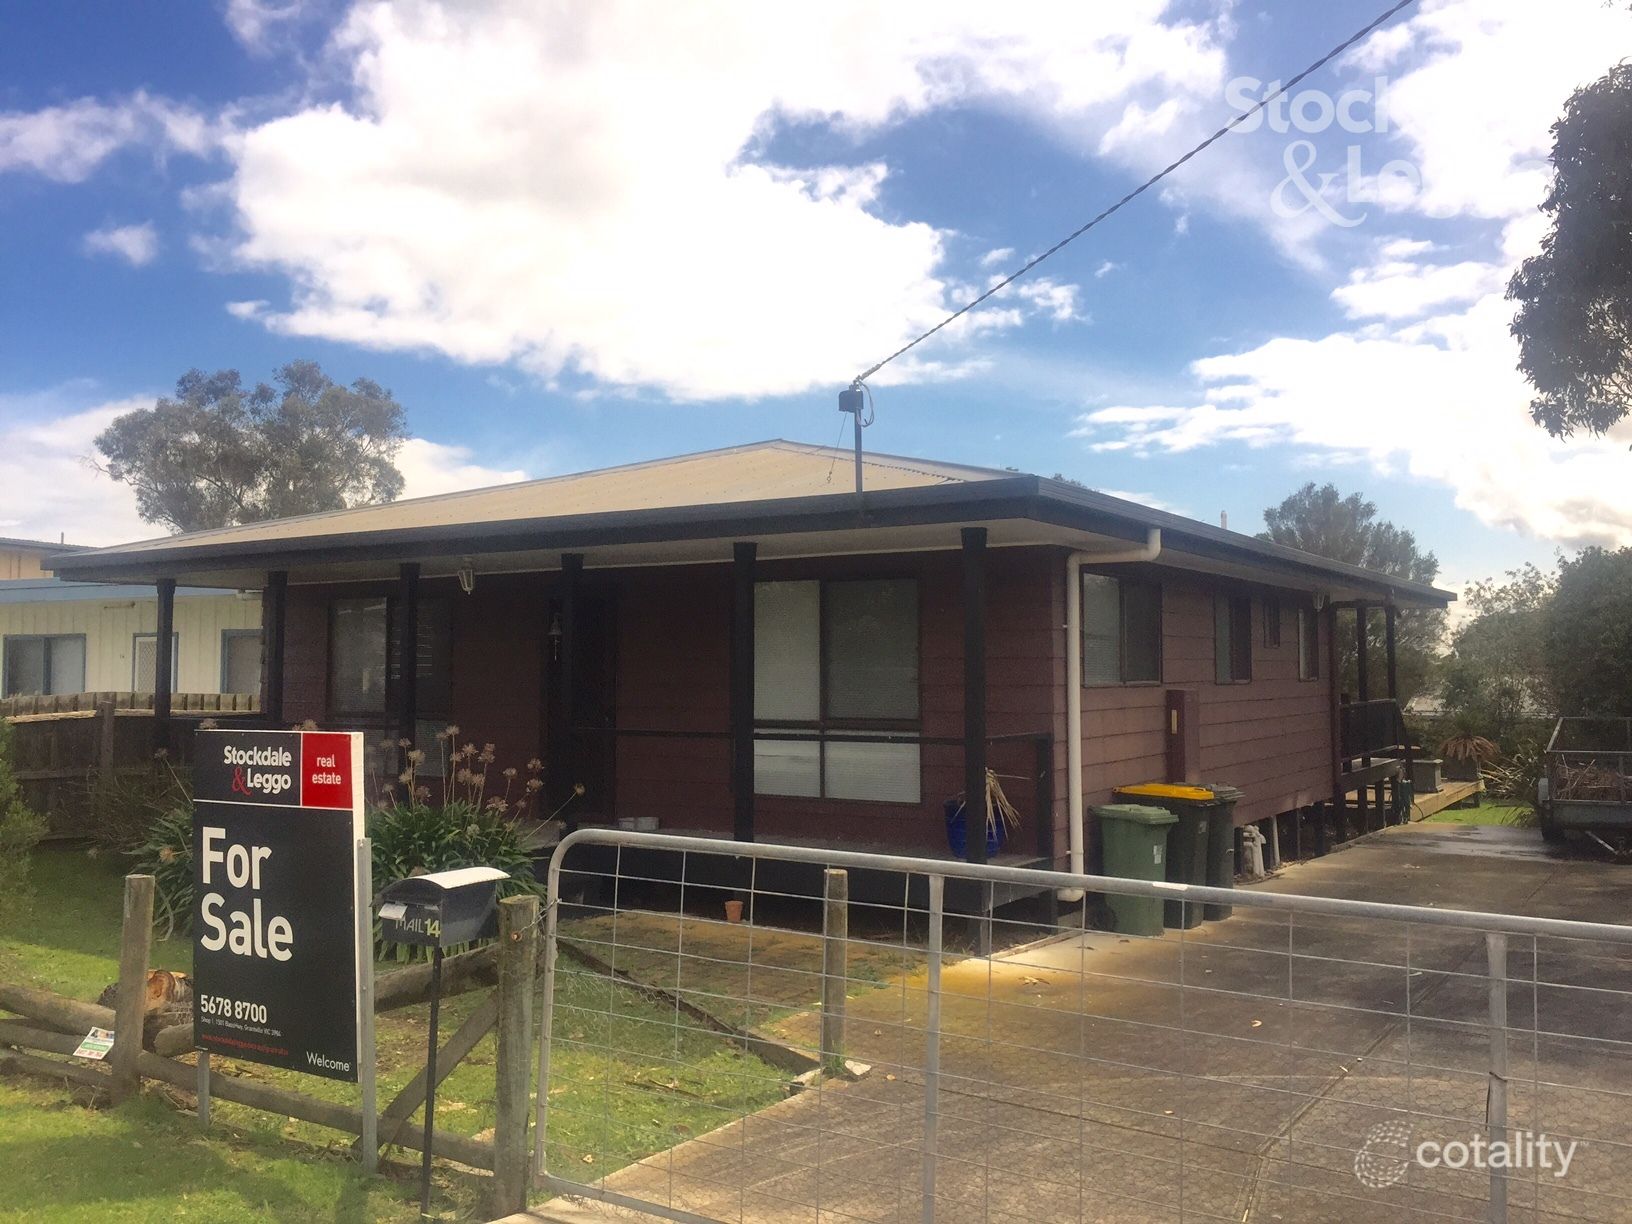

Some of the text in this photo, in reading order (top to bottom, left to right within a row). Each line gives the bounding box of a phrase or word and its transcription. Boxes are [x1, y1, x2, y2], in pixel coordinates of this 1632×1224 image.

[223, 745, 292, 767] Stockdale
[316, 753, 336, 768] real
[311, 772, 342, 785] estate
[202, 826, 273, 890] For
[200, 892, 294, 962] Sale
[424, 918, 441, 938] 14
[200, 994, 267, 1024] 5678 8700
[306, 1051, 350, 1073] Welcome
